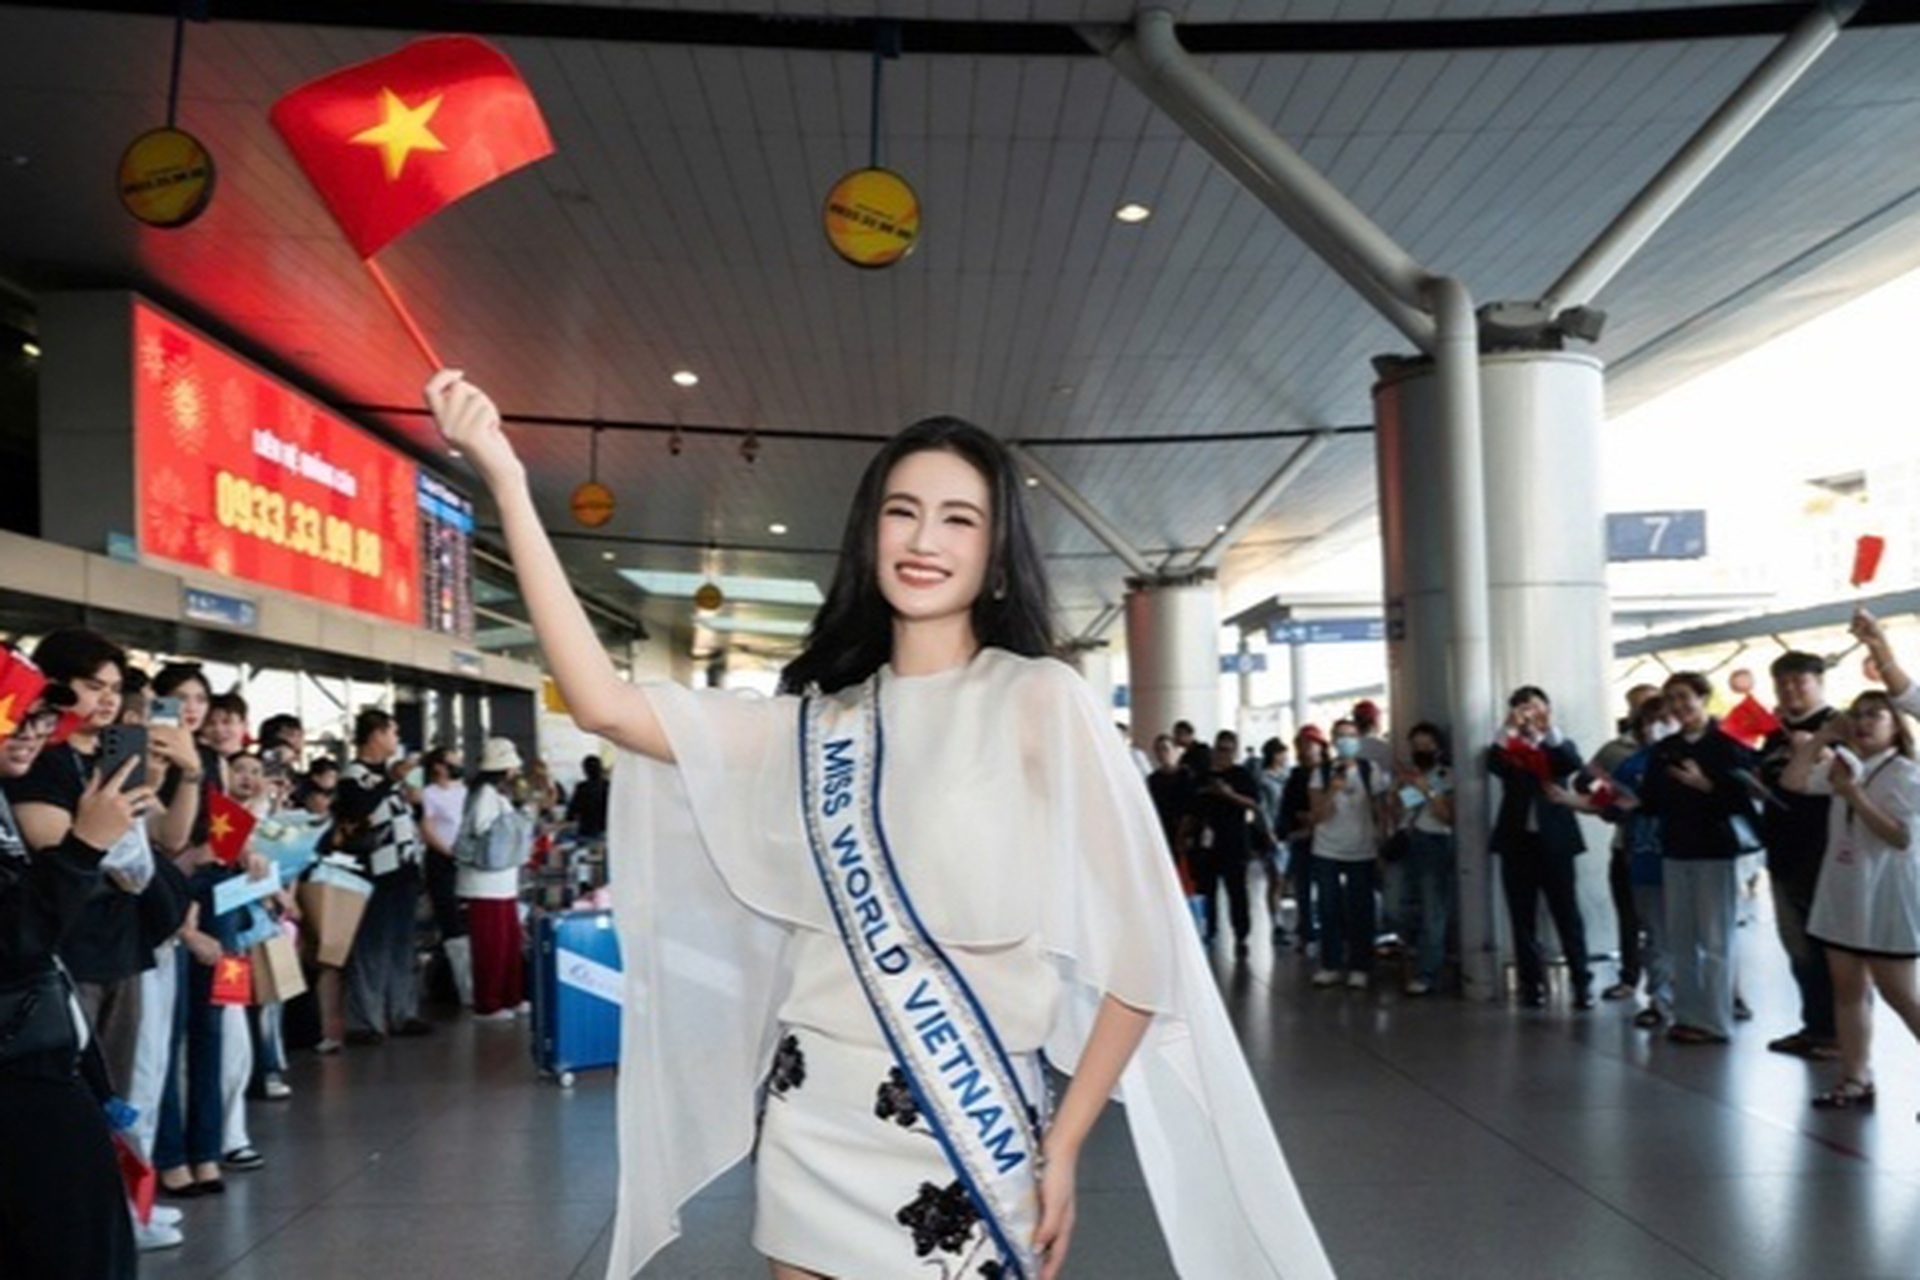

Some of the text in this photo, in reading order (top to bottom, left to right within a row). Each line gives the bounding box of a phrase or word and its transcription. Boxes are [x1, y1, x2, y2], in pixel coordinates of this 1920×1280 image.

[1642, 516, 1671, 554] 7
[822, 738, 1026, 1175] MISS WORLD VIETNAM
